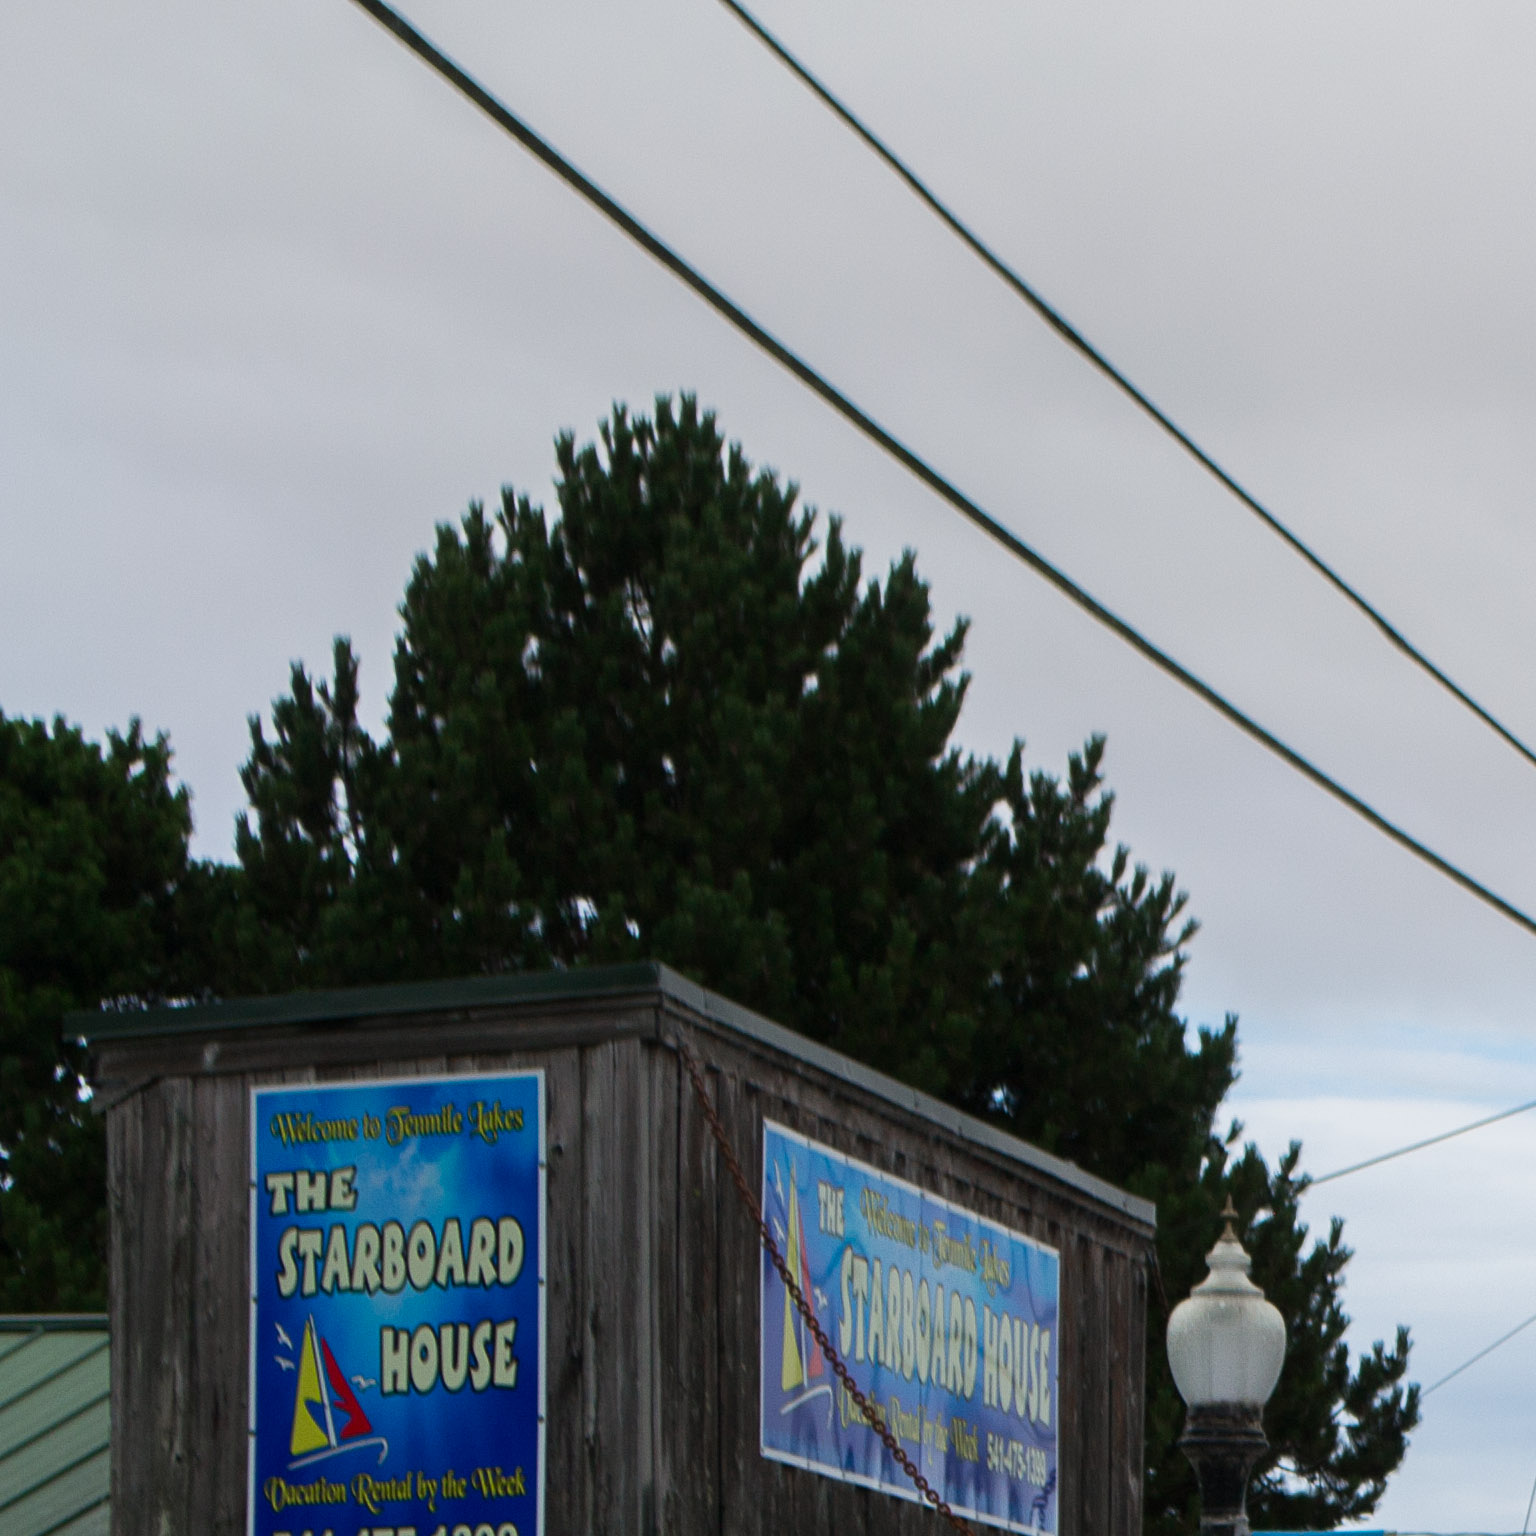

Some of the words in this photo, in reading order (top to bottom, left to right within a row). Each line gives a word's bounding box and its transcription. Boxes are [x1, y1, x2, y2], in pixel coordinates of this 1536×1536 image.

[270, 1111, 358, 1149] Welcome
[362, 1110, 381, 1140] to
[385, 1104, 462, 1146] Tenmile
[467, 1100, 524, 1144] Lakes
[265, 1165, 358, 1216] THE
[818, 1180, 845, 1239] THE
[860, 1186, 915, 1249] Welcome
[918, 1219, 930, 1255] to
[276, 1216, 525, 1299] STARBOARD
[380, 1317, 518, 1397] HOUSE
[839, 1244, 978, 1402] STARBOARD
[982, 1303, 1051, 1428] HOUSE
[951, 1416, 979, 1463] Week
[986, 1430, 1047, 1488] 541-475-1399
[264, 1476, 347, 1513] Vacation
[351, 1471, 412, 1516] Rental
[416, 1469, 438, 1513] by
[441, 1468, 467, 1500] the
[471, 1465, 526, 1500] Week
